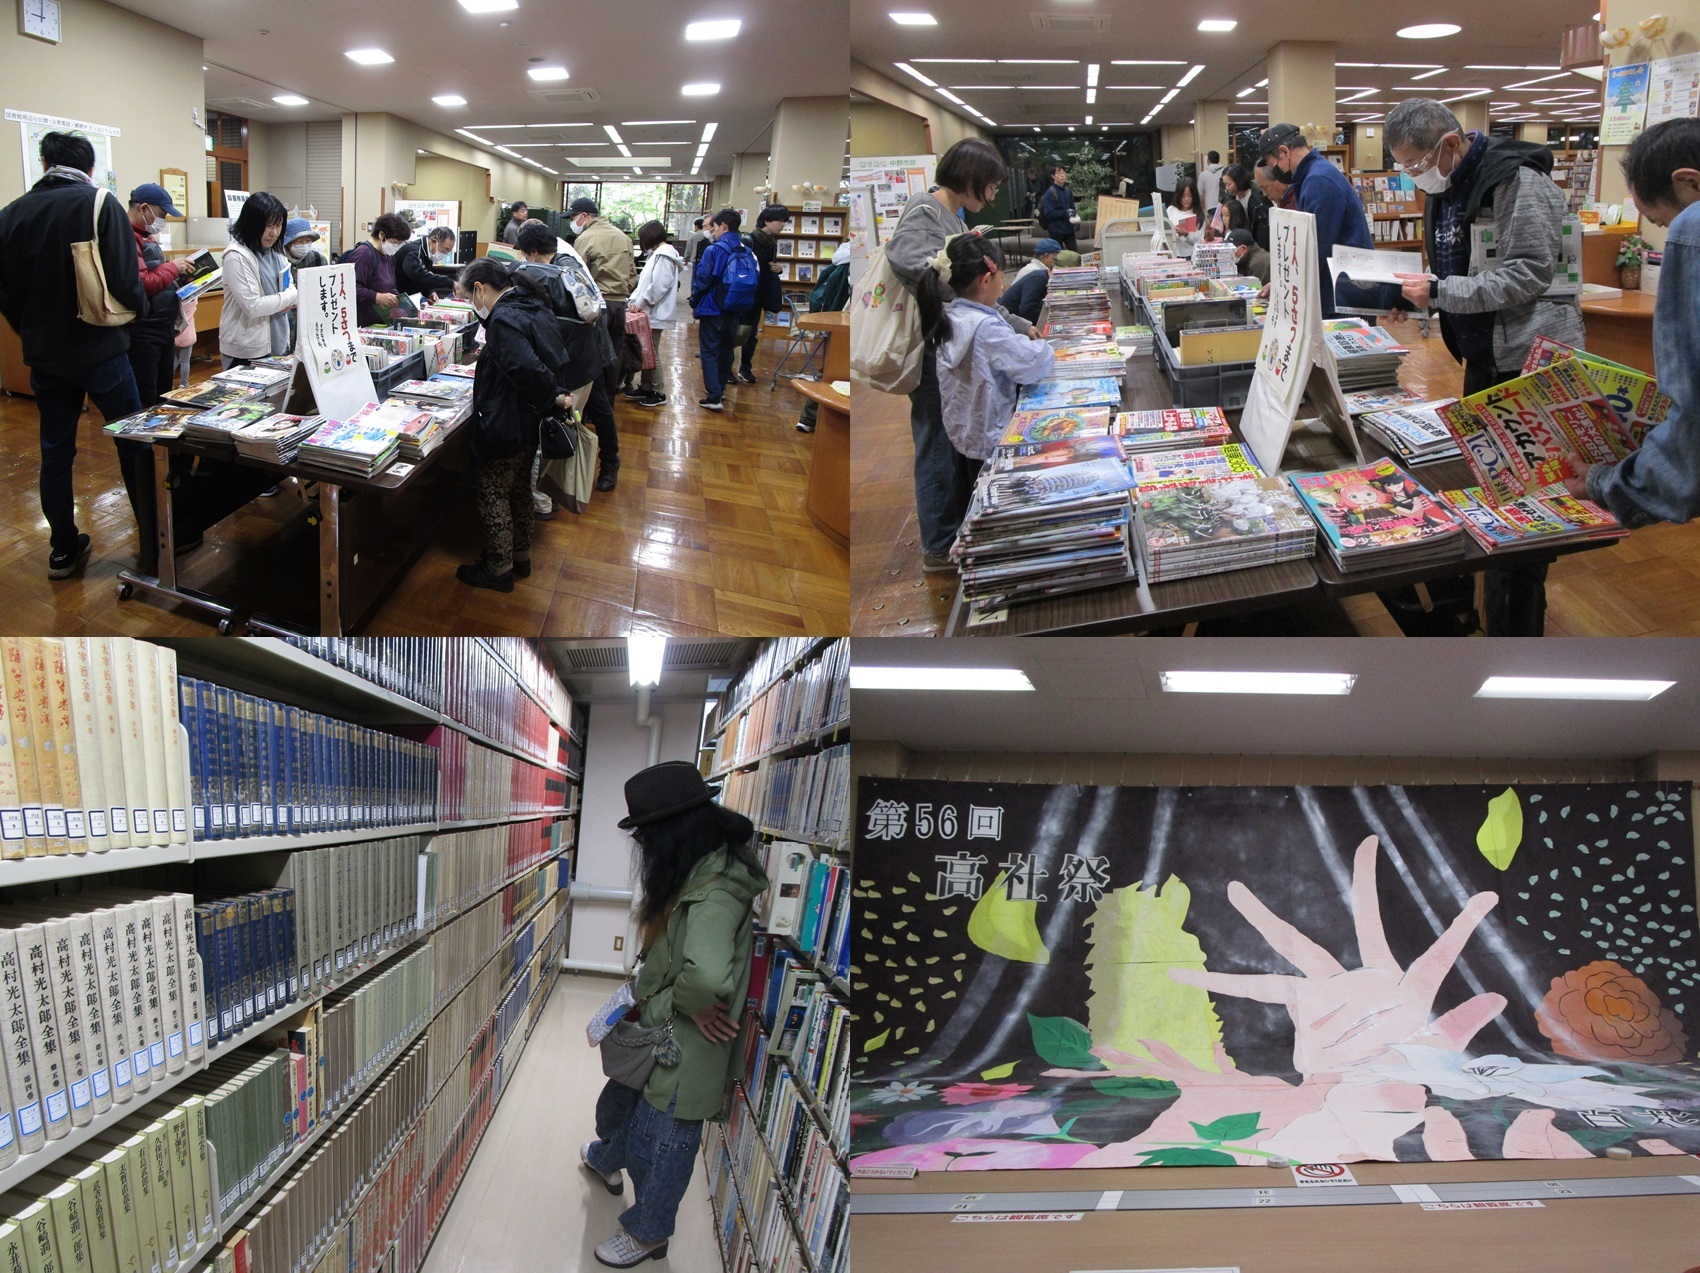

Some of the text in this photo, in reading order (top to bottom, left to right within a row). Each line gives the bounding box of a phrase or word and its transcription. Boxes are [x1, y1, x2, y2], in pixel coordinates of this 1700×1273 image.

[319, 276, 329, 318] します。
[329, 274, 339, 334] プレゼント
[1497, 382, 1562, 457] パスワード
[1466, 430, 1508, 483] PC21
[1463, 507, 1501, 539] PC21
[865, 798, 1004, 840] 第56回
[935, 851, 1110, 903] 高社祭
[103, 926, 124, 1026] 高村光太郎全集
[125, 922, 144, 1019] 高村光太郎全集
[141, 917, 159, 1010] 高村光太郎全集
[162, 913, 178, 1003] 高村光太郎全集
[184, 907, 198, 994] 高村光太郎全集
[1, 951, 31, 1068] 高村光太郎全集
[29, 944, 57, 1056] 高村光太郎全集
[56, 938, 81, 1045] 高村光太郎全集
[79, 932, 102, 1037] 高村光太郎全集
[119, 1164, 131, 1215] 志賀直哉集
[139, 1147, 149, 1197] 有島武郎集
[1423, 1201, 1534, 1209] こちらは観覧席です
[954, 1213, 1077, 1221] こちらは観覧席です
